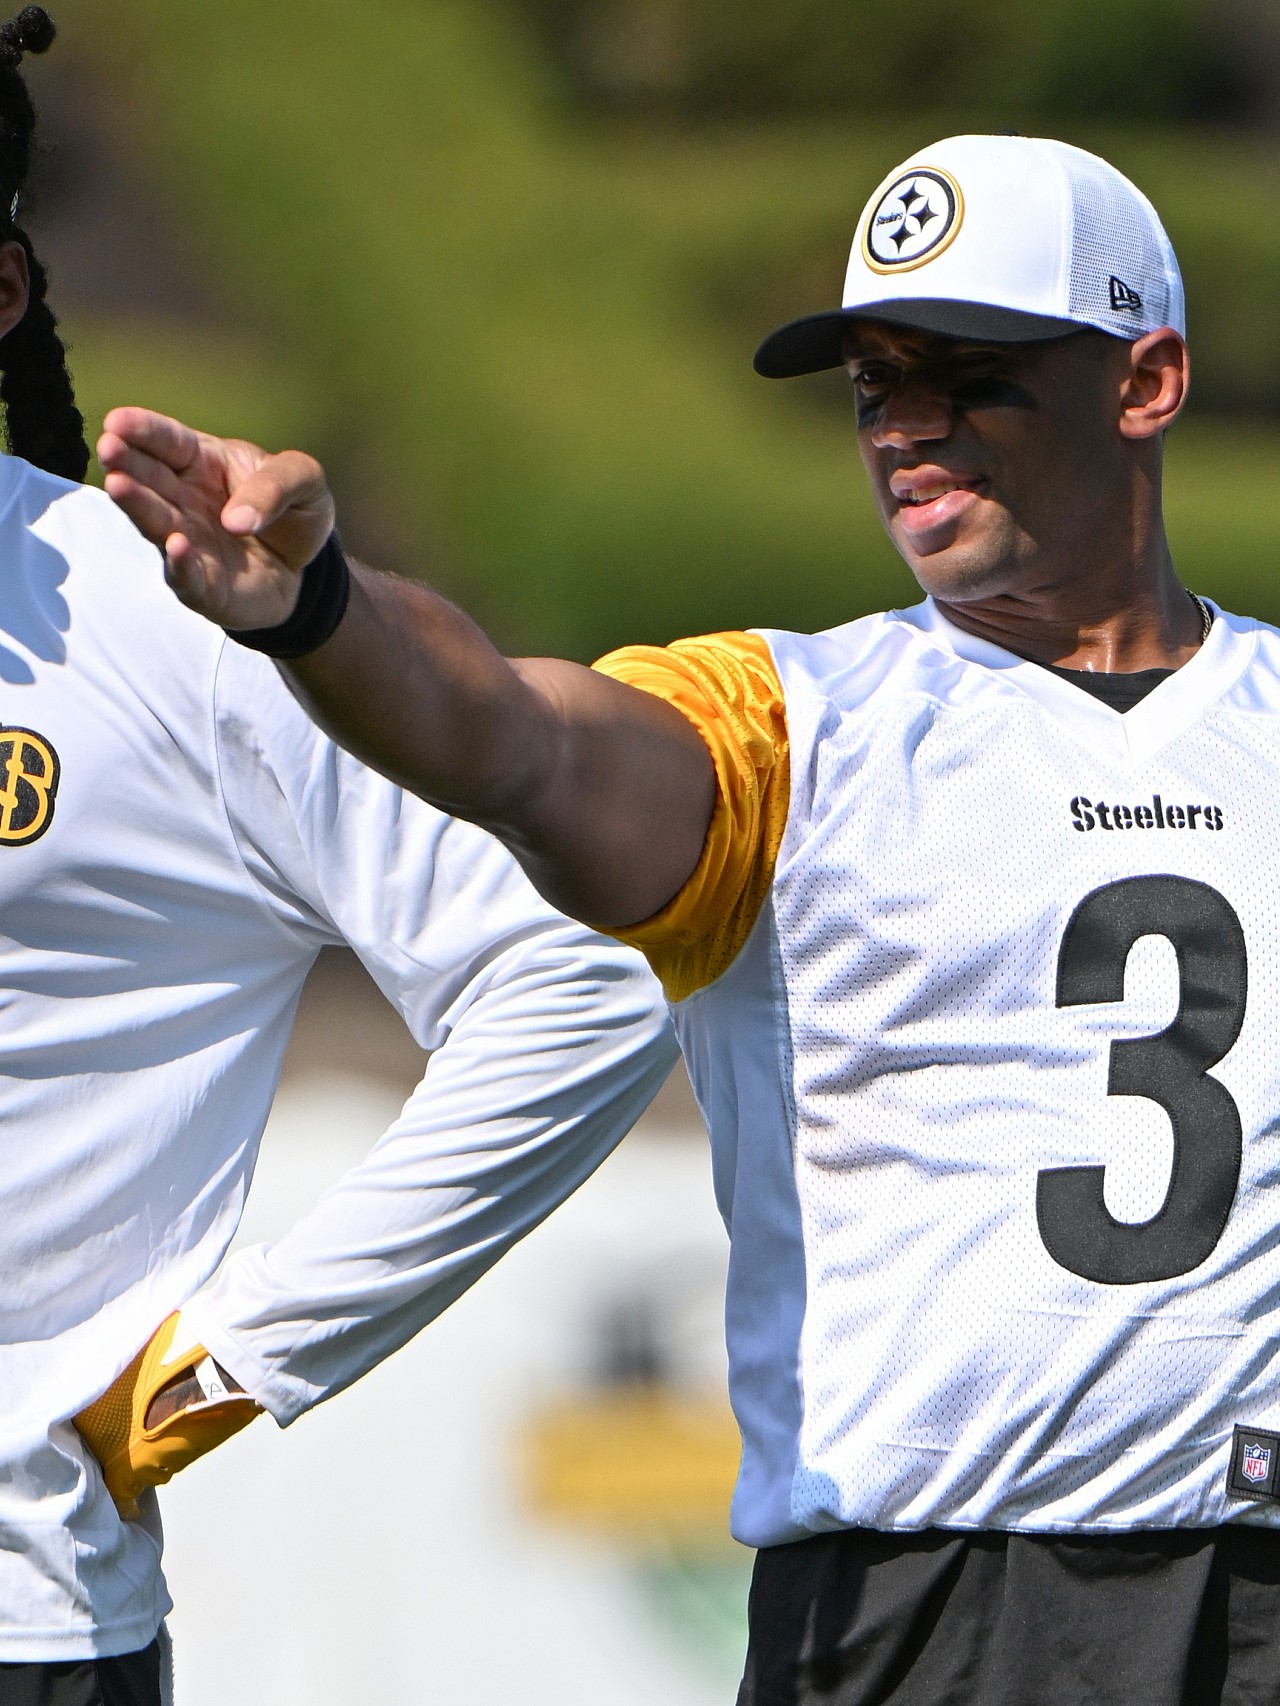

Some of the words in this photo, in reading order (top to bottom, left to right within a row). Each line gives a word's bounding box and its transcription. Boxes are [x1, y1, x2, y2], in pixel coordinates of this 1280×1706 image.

[1070, 794, 1224, 832] Steelers
[1036, 873, 1248, 1285] 3
[1245, 1457, 1265, 1477] NFL
